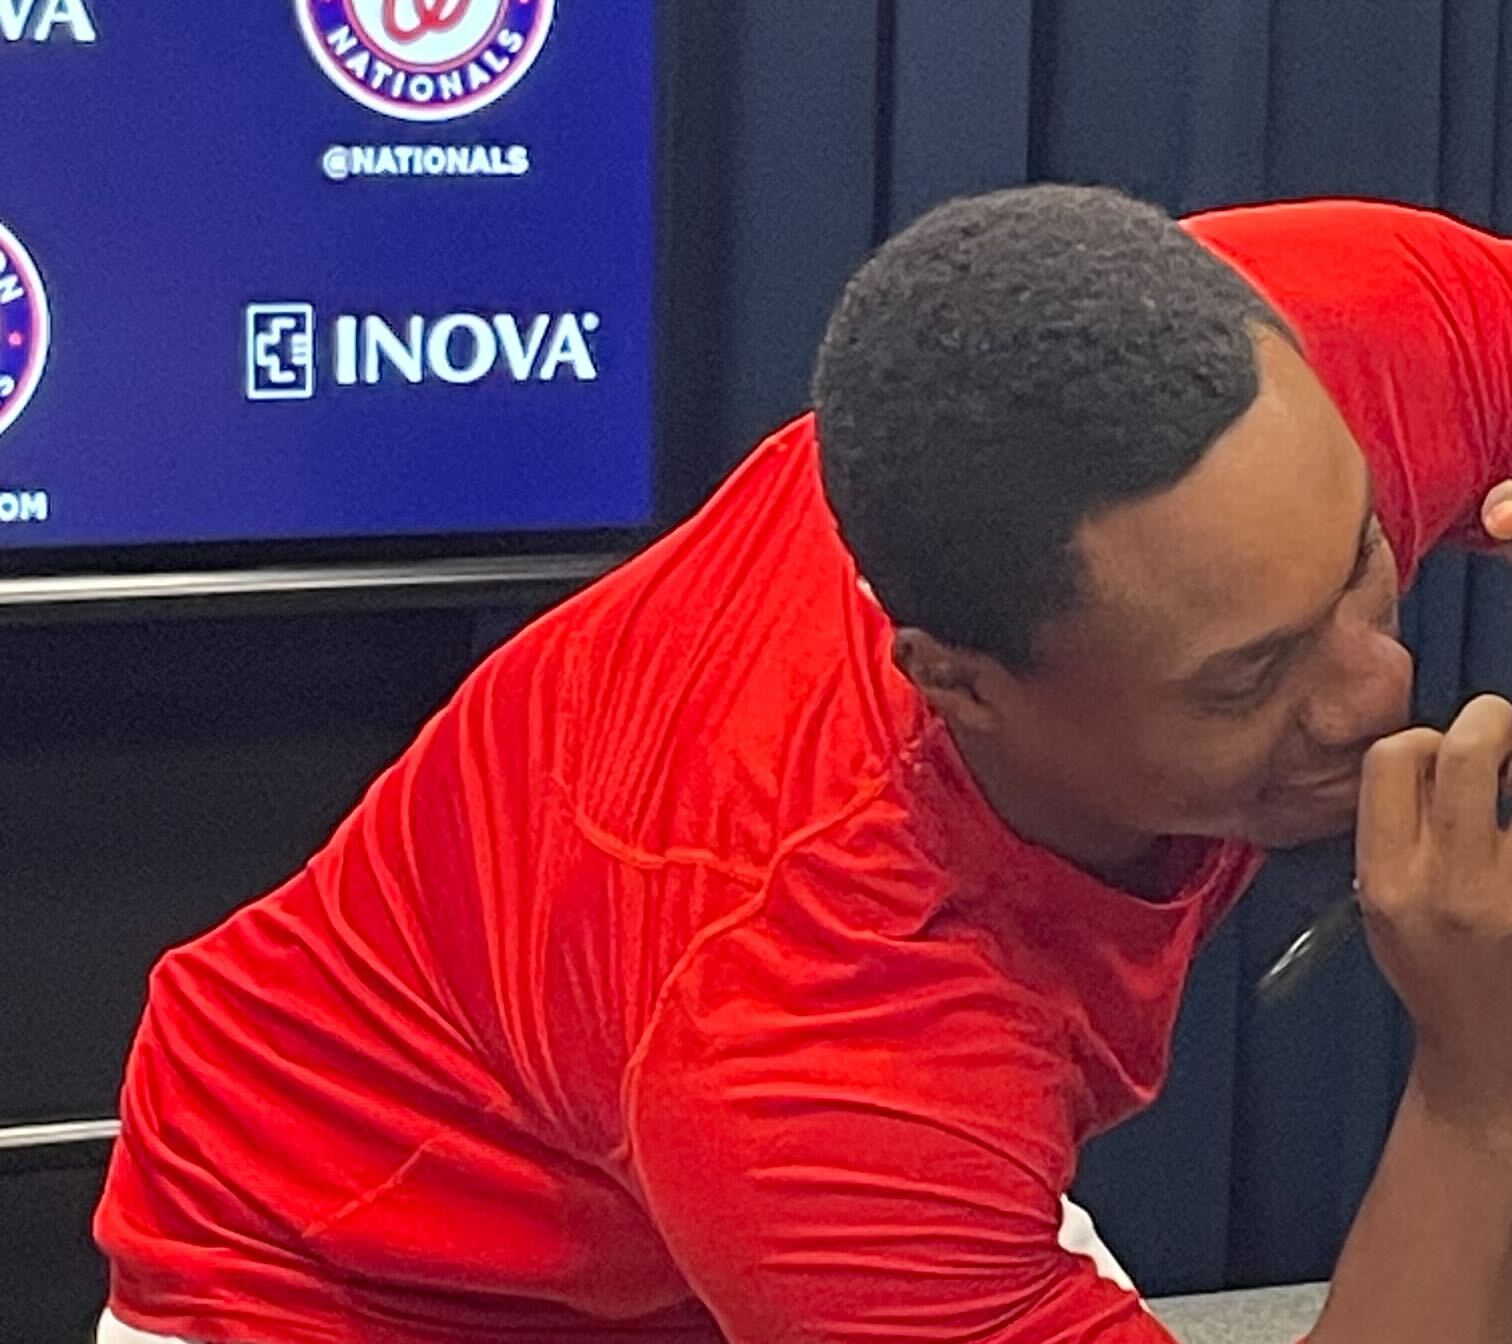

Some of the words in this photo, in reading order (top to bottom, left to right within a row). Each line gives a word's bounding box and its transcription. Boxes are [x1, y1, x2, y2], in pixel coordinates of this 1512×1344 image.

[327, 25, 527, 102] NATIONALS
[322, 145, 529, 179] @NATIONALS
[335, 312, 598, 385] INOVA
